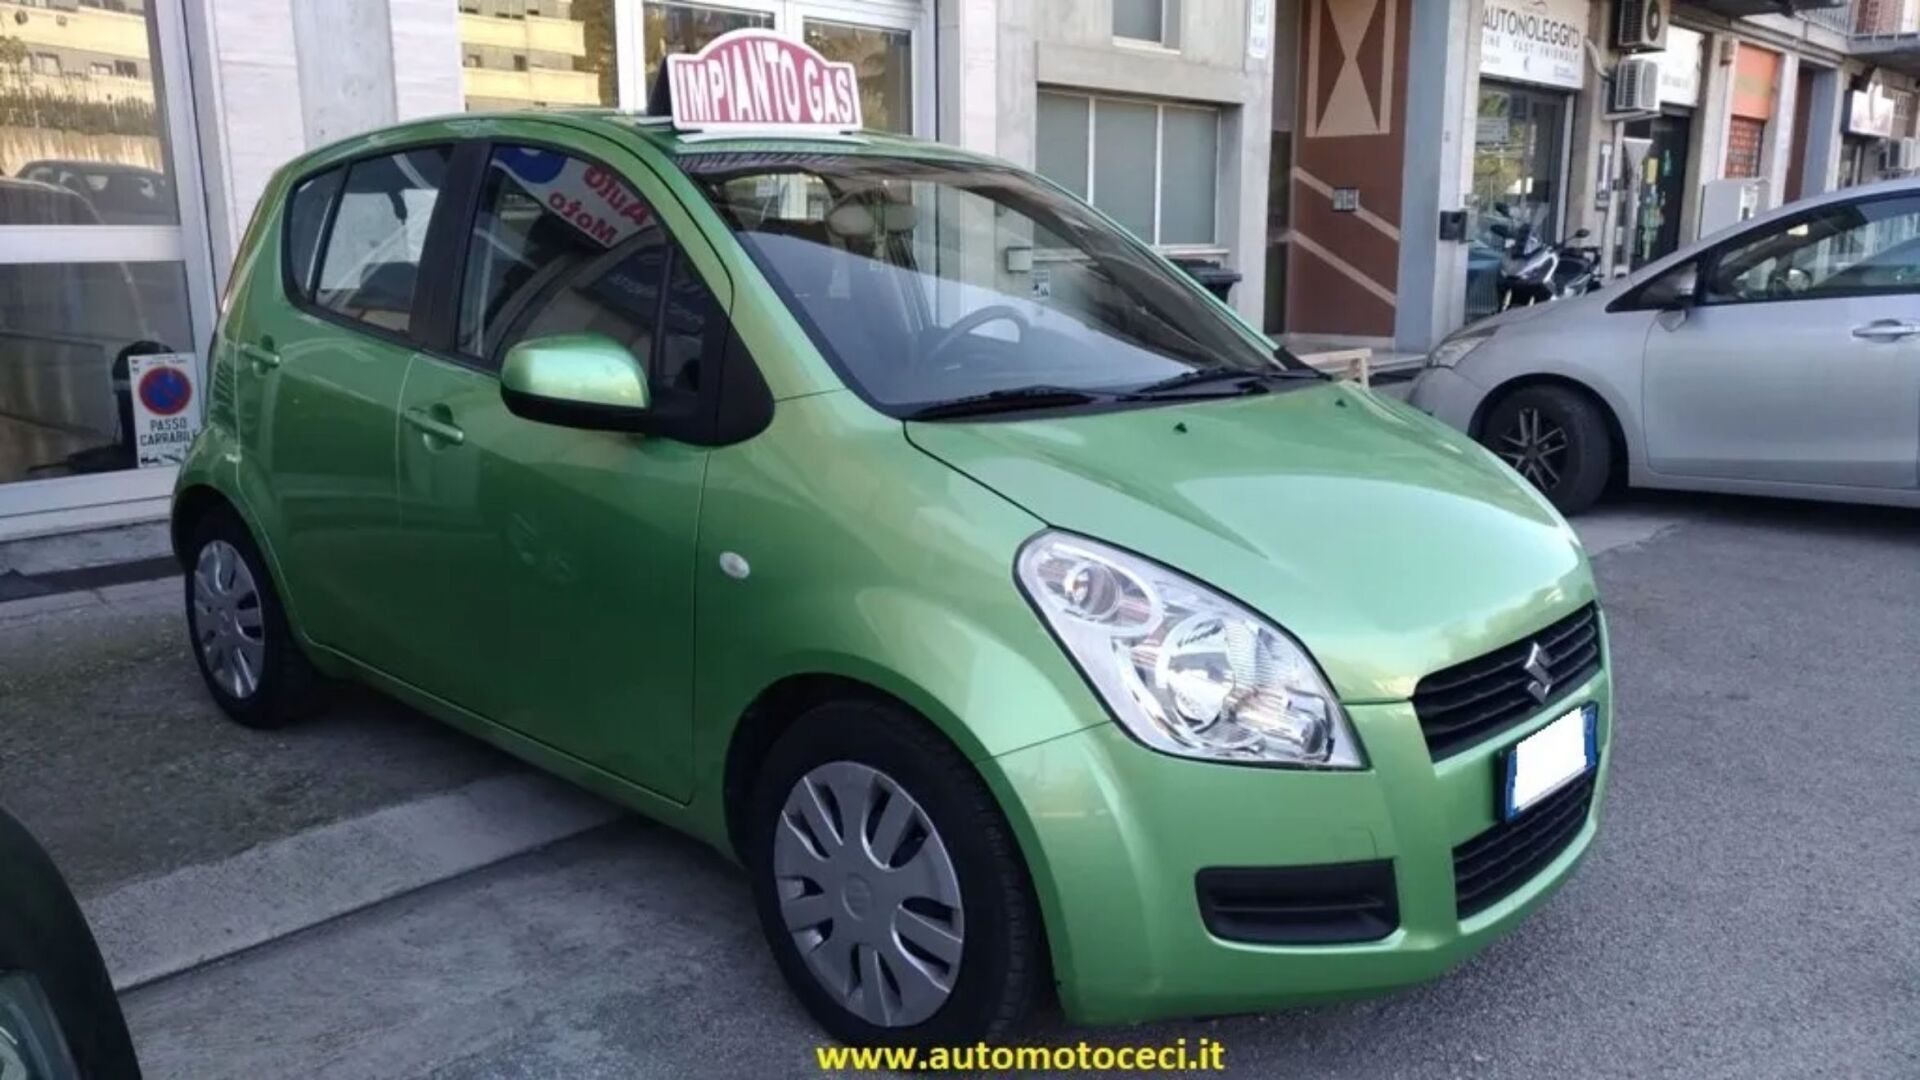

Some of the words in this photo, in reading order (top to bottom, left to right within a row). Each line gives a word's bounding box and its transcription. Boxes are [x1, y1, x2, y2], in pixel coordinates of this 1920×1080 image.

[678, 40, 800, 122] IMPIANTO
[803, 58, 852, 123] GAS
[150, 417, 187, 431] PASSO
